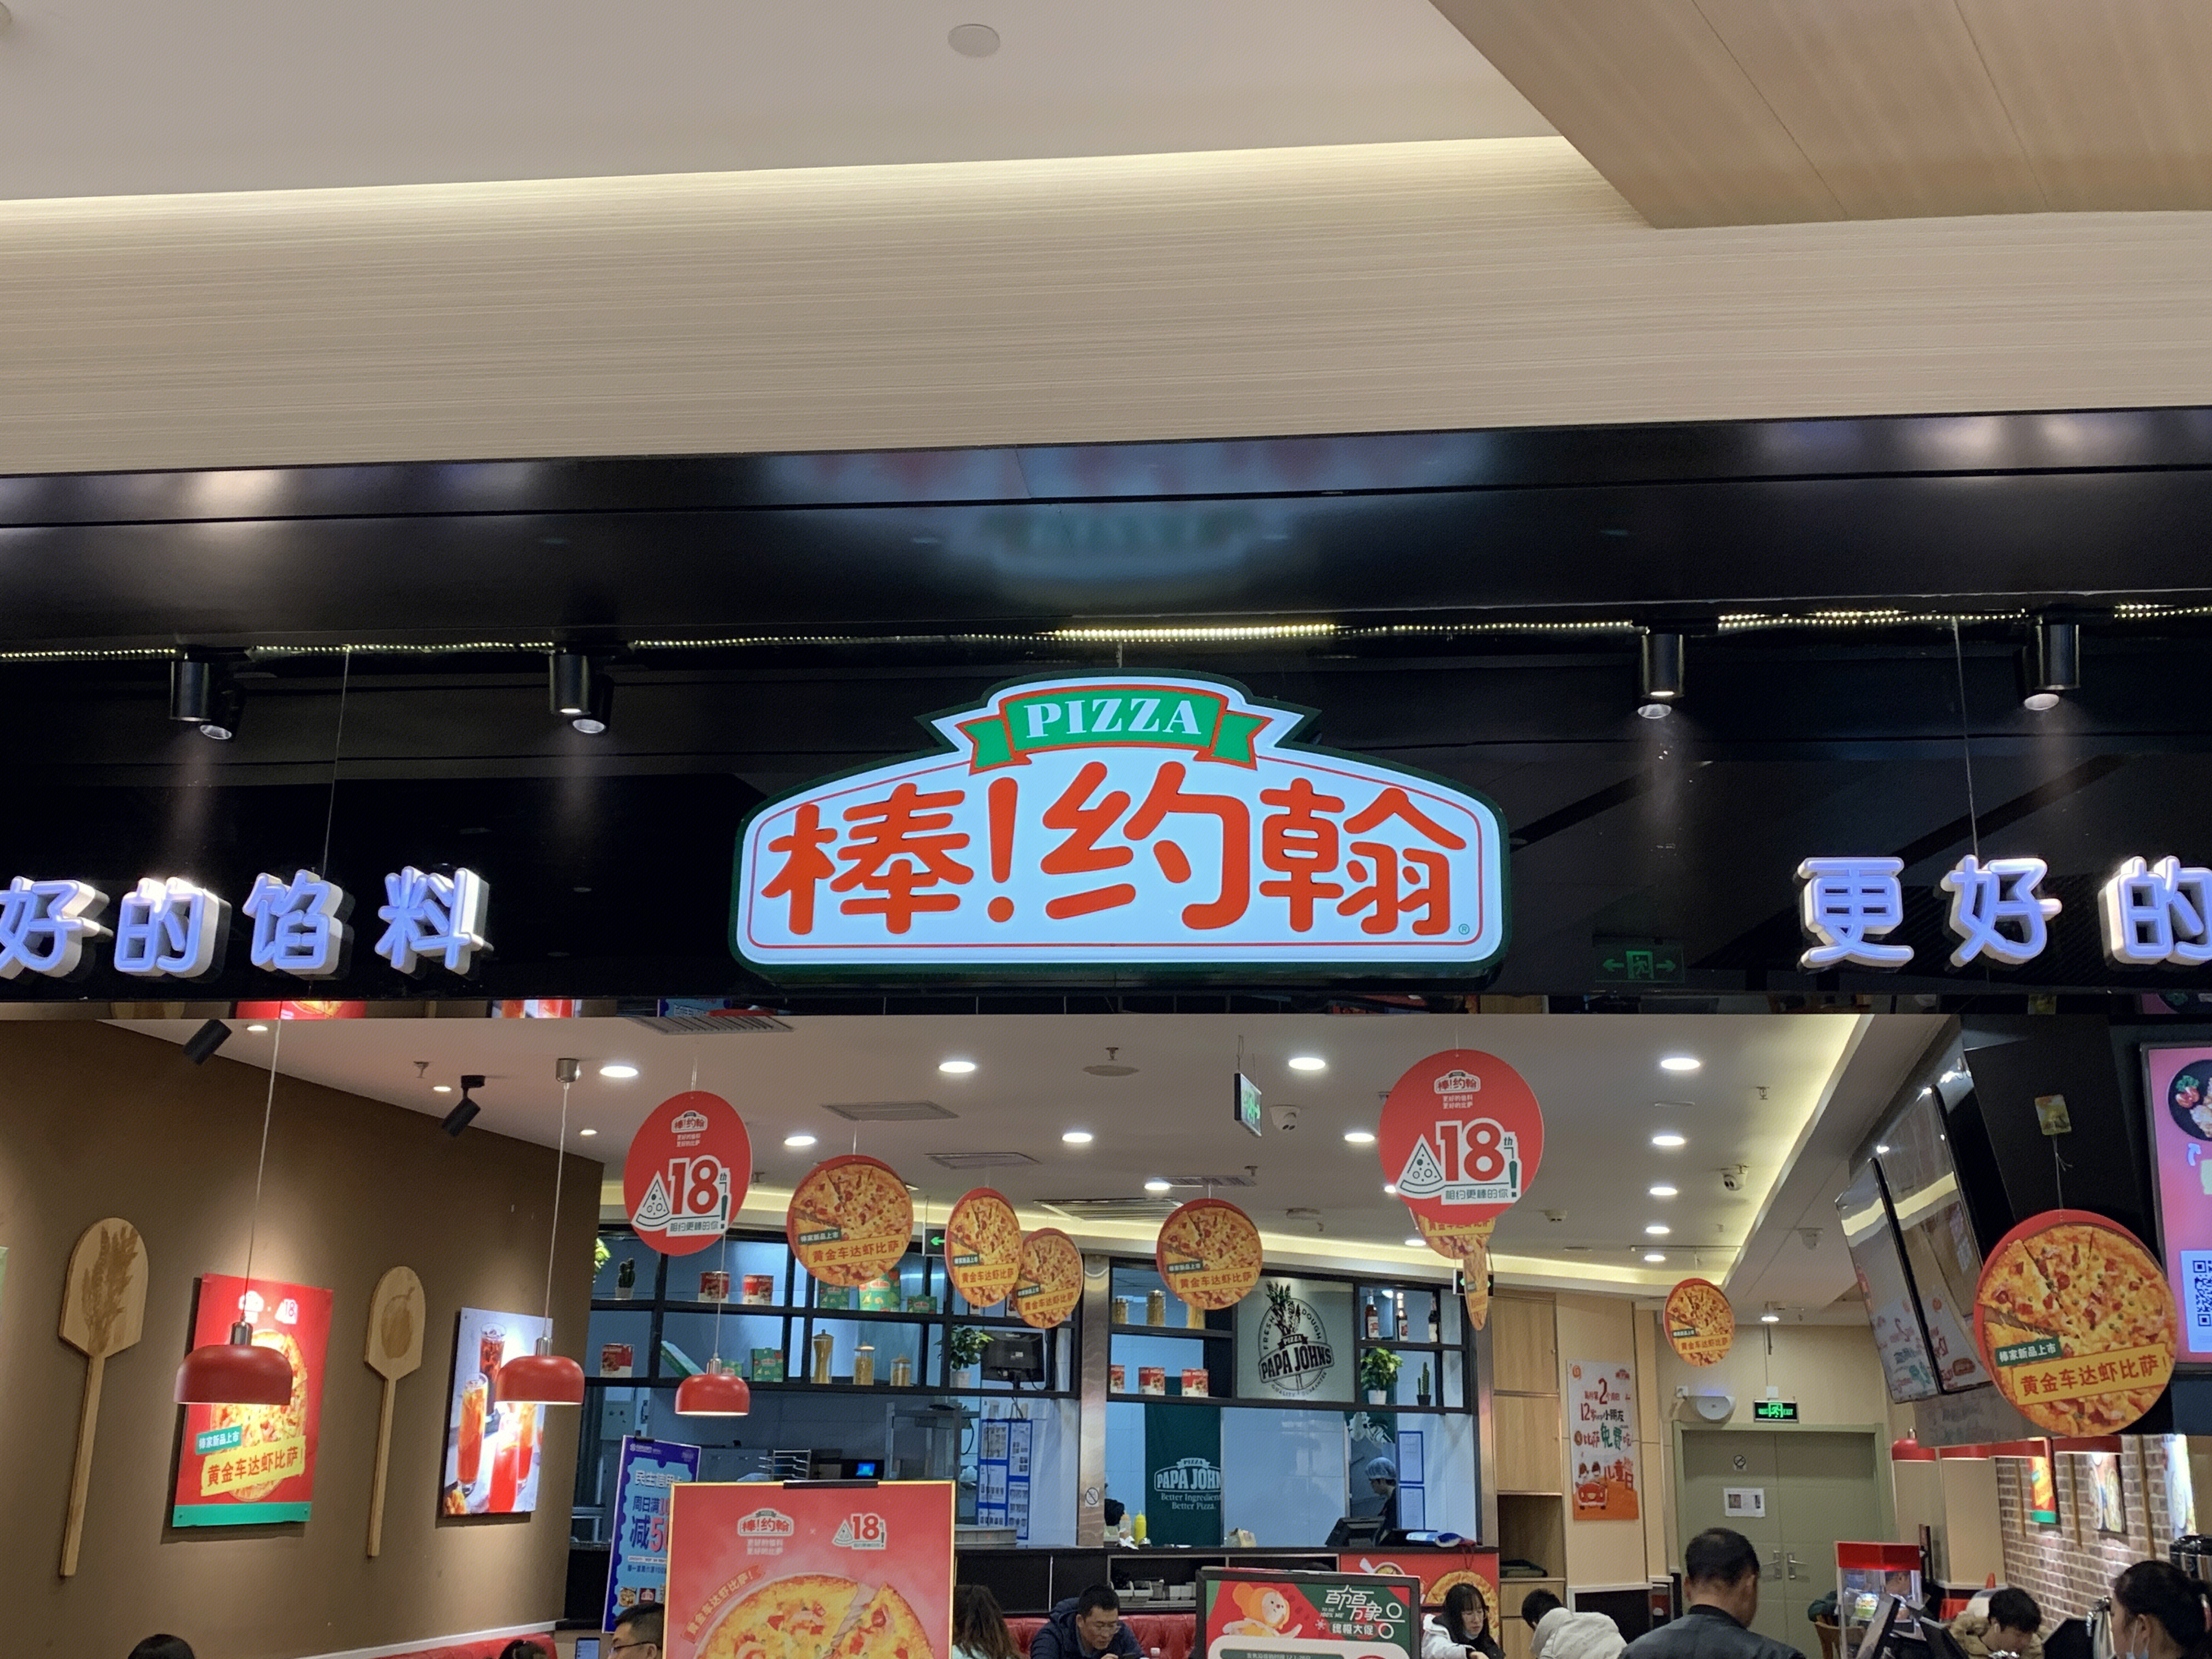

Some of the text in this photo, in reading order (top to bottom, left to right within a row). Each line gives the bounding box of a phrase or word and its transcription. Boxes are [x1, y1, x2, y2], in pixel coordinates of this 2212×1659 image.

[1023, 698, 1201, 738] PIZZA
[0, 865, 486, 974] 好的馅料
[1797, 854, 2212, 968] 更好的
[1440, 1122, 1513, 1182] 18 th
[672, 1159, 719, 1215] 18
[1263, 1315, 1275, 1350] FRESH
[1301, 1308, 1322, 1340] DOUGH
[1261, 1345, 1332, 1380] PAPA JOHNS
[1156, 1469, 1189, 1489] PAPA
[1171, 1502, 1194, 1510] Better
[853, 1515, 879, 1540] 18
